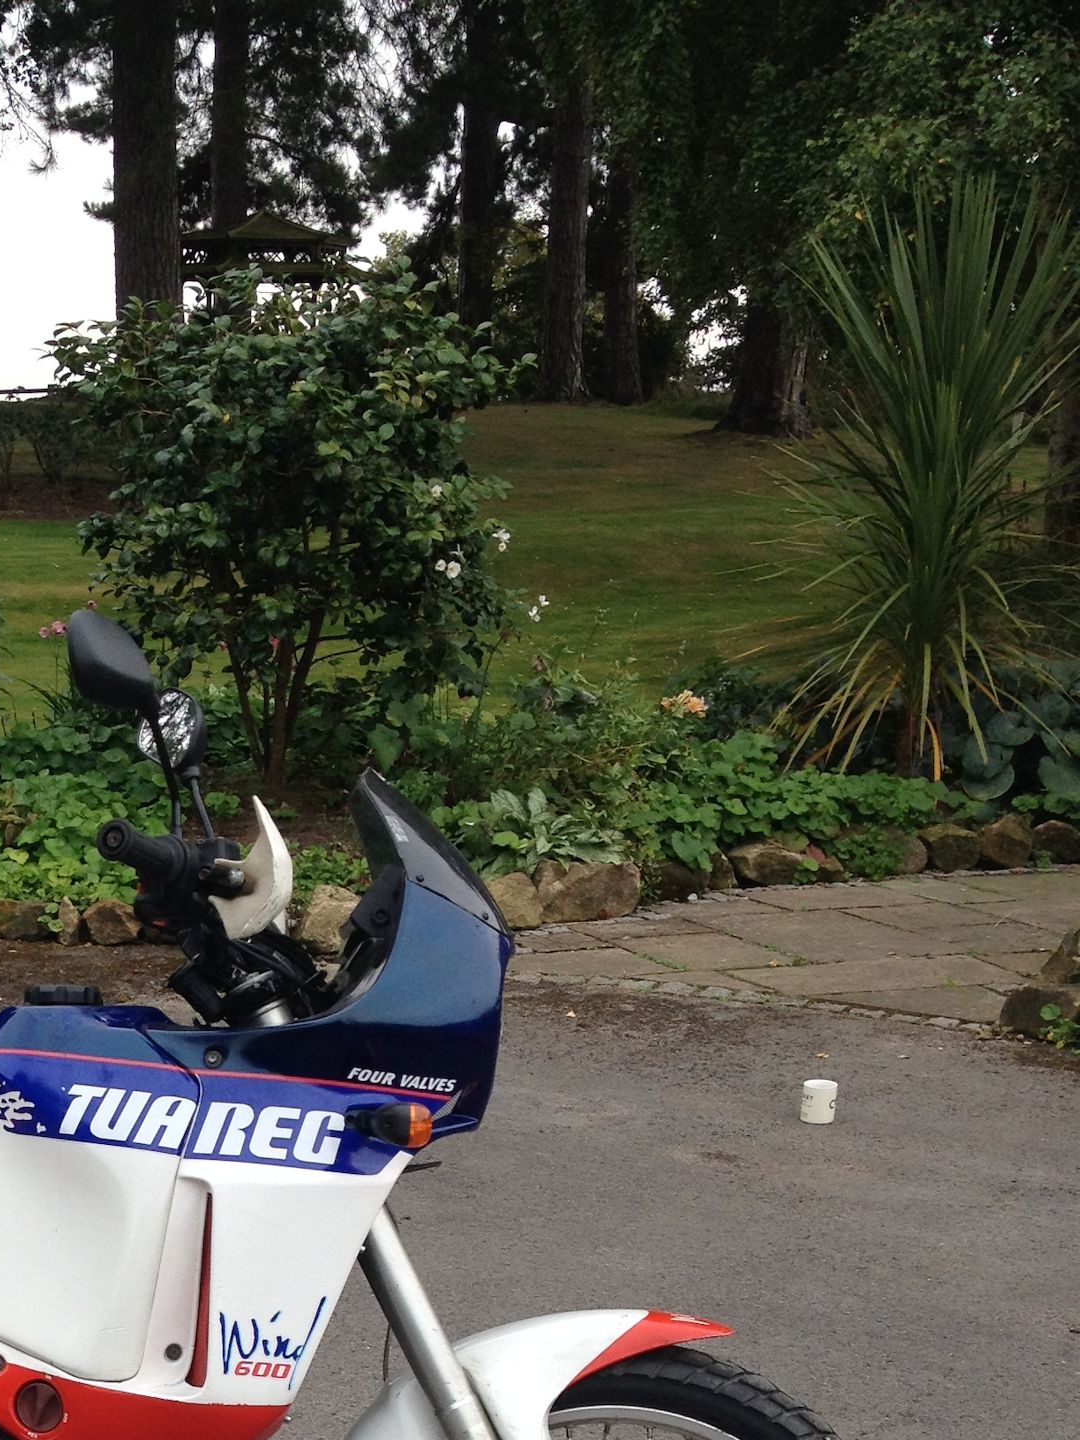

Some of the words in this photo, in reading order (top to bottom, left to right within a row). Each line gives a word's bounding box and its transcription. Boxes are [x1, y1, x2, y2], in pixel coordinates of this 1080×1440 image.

[347, 1067, 396, 1086] FOUR
[399, 1074, 457, 1093] VALVES
[59, 1084, 345, 1165] TUAREG
[219, 1296, 326, 1390] Wind
[234, 1361, 291, 1379] 600
